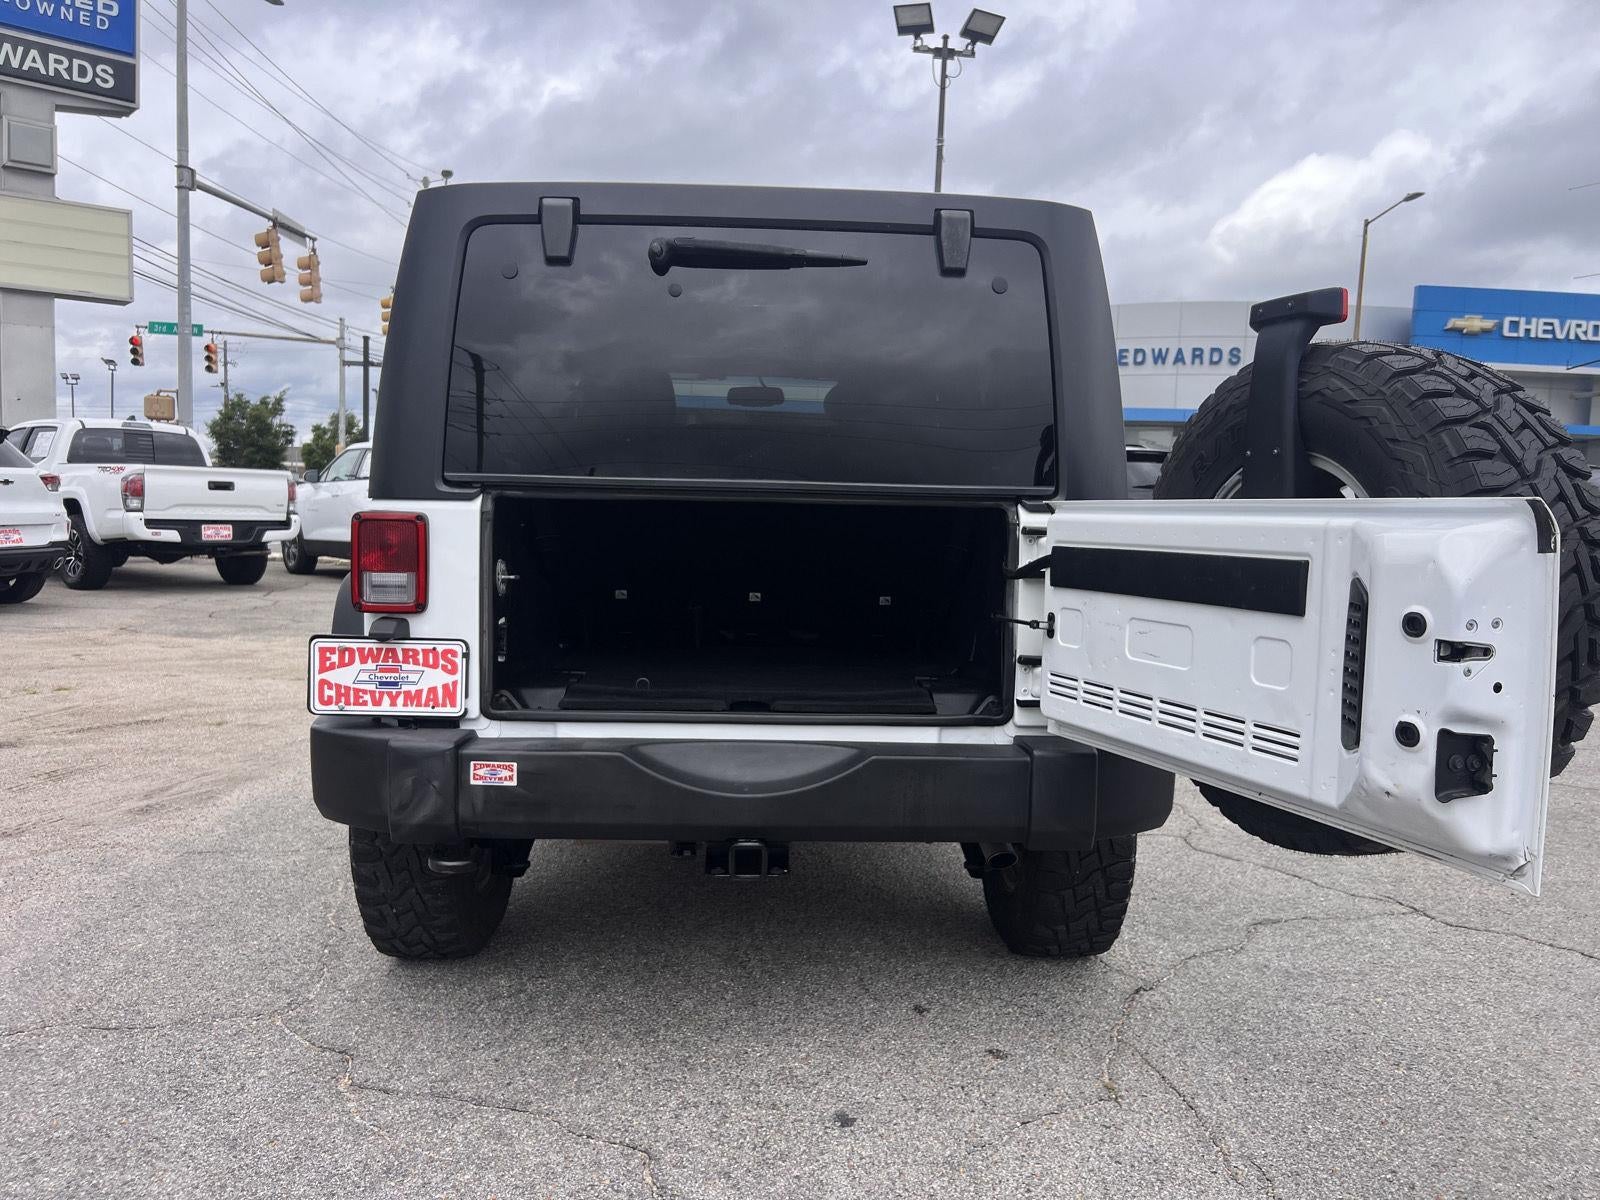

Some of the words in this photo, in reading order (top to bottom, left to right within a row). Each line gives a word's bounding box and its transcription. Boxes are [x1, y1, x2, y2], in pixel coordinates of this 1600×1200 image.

[153, 324, 167, 333] 3rd
[1503, 317, 1600, 341] CHEVRO
[1118, 347, 1242, 366] EDWARDS
[318, 646, 459, 675] EDWARDS
[368, 673, 409, 681] Chevrolet
[318, 678, 459, 708] CHEVYMAN
[473, 763, 514, 772] EDWARDS
[473, 773, 514, 782] CHEVYMAN
